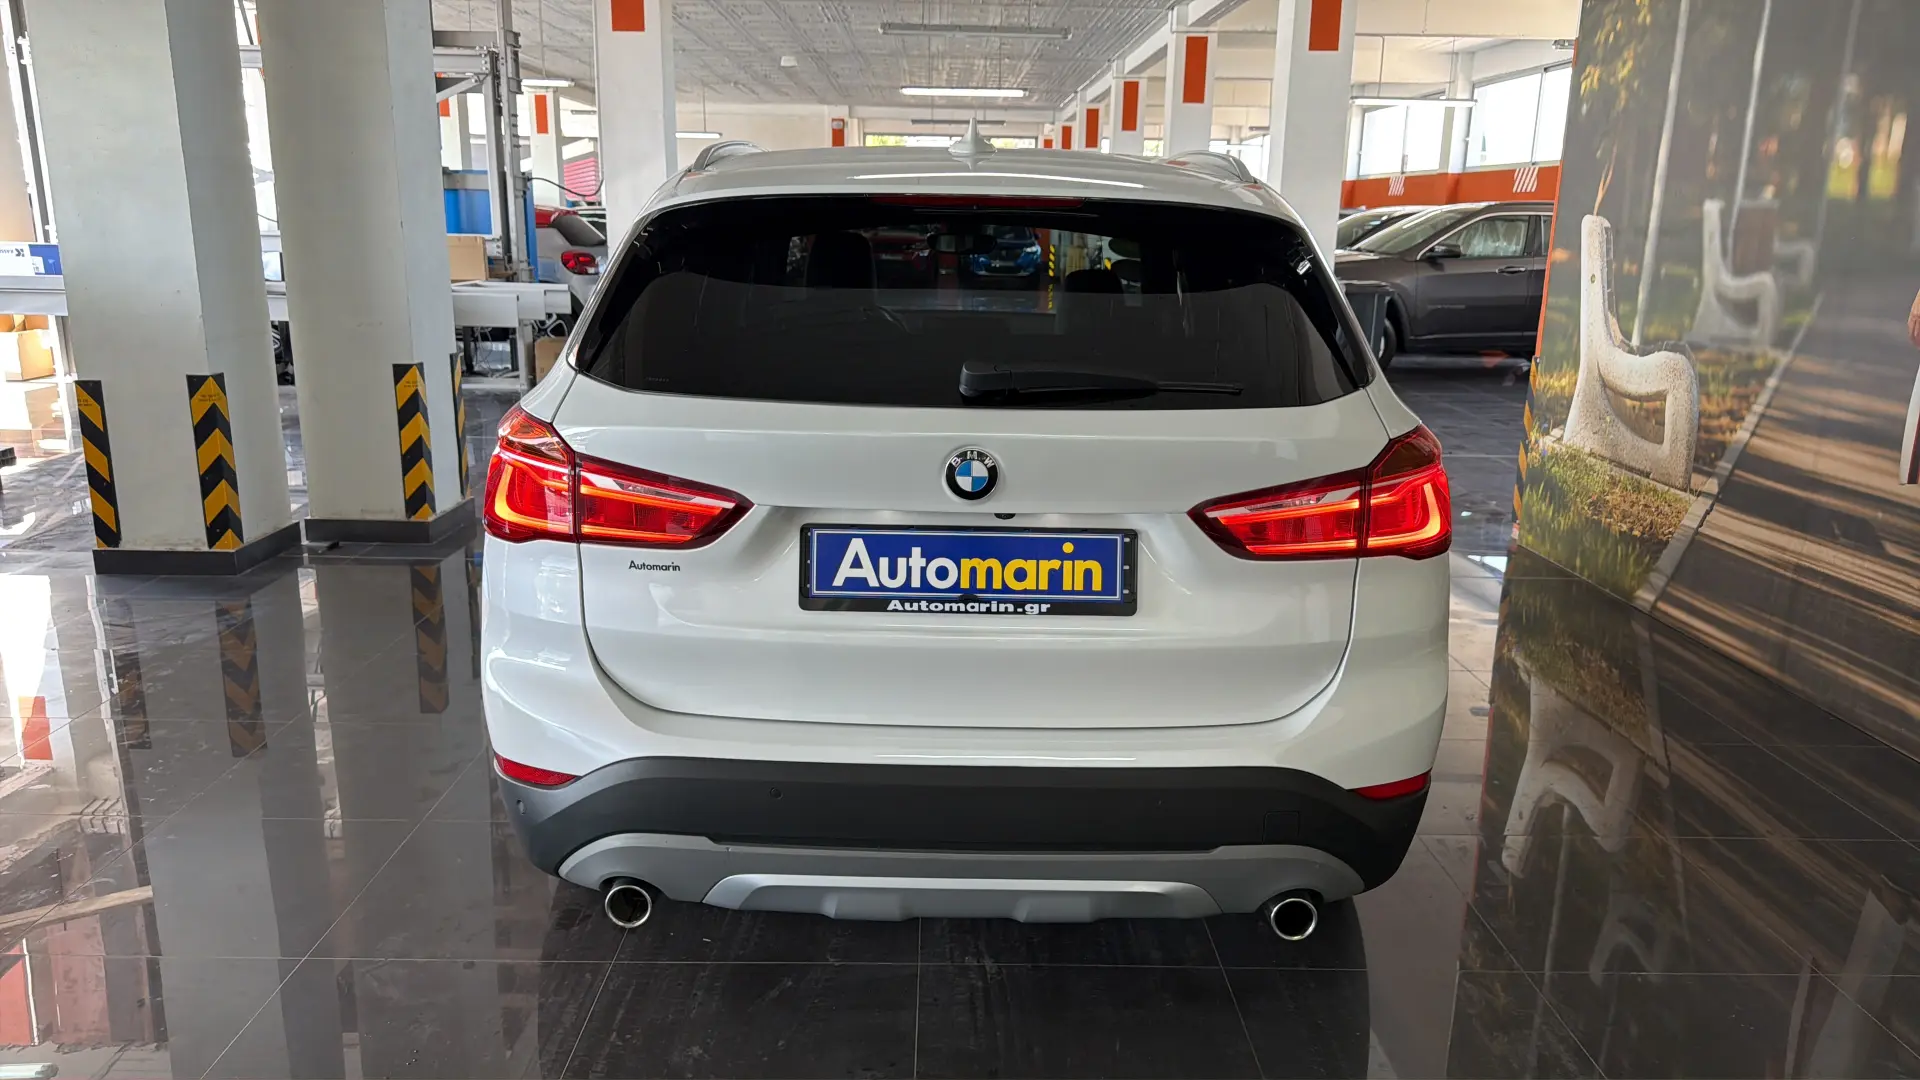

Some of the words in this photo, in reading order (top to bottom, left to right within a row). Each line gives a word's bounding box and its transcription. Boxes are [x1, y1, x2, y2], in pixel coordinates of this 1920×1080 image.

[951, 450, 995, 468] BMW
[628, 560, 681, 572] Automarin
[832, 537, 1103, 592] Automarin
[887, 599, 1051, 615] Automarin.gr
